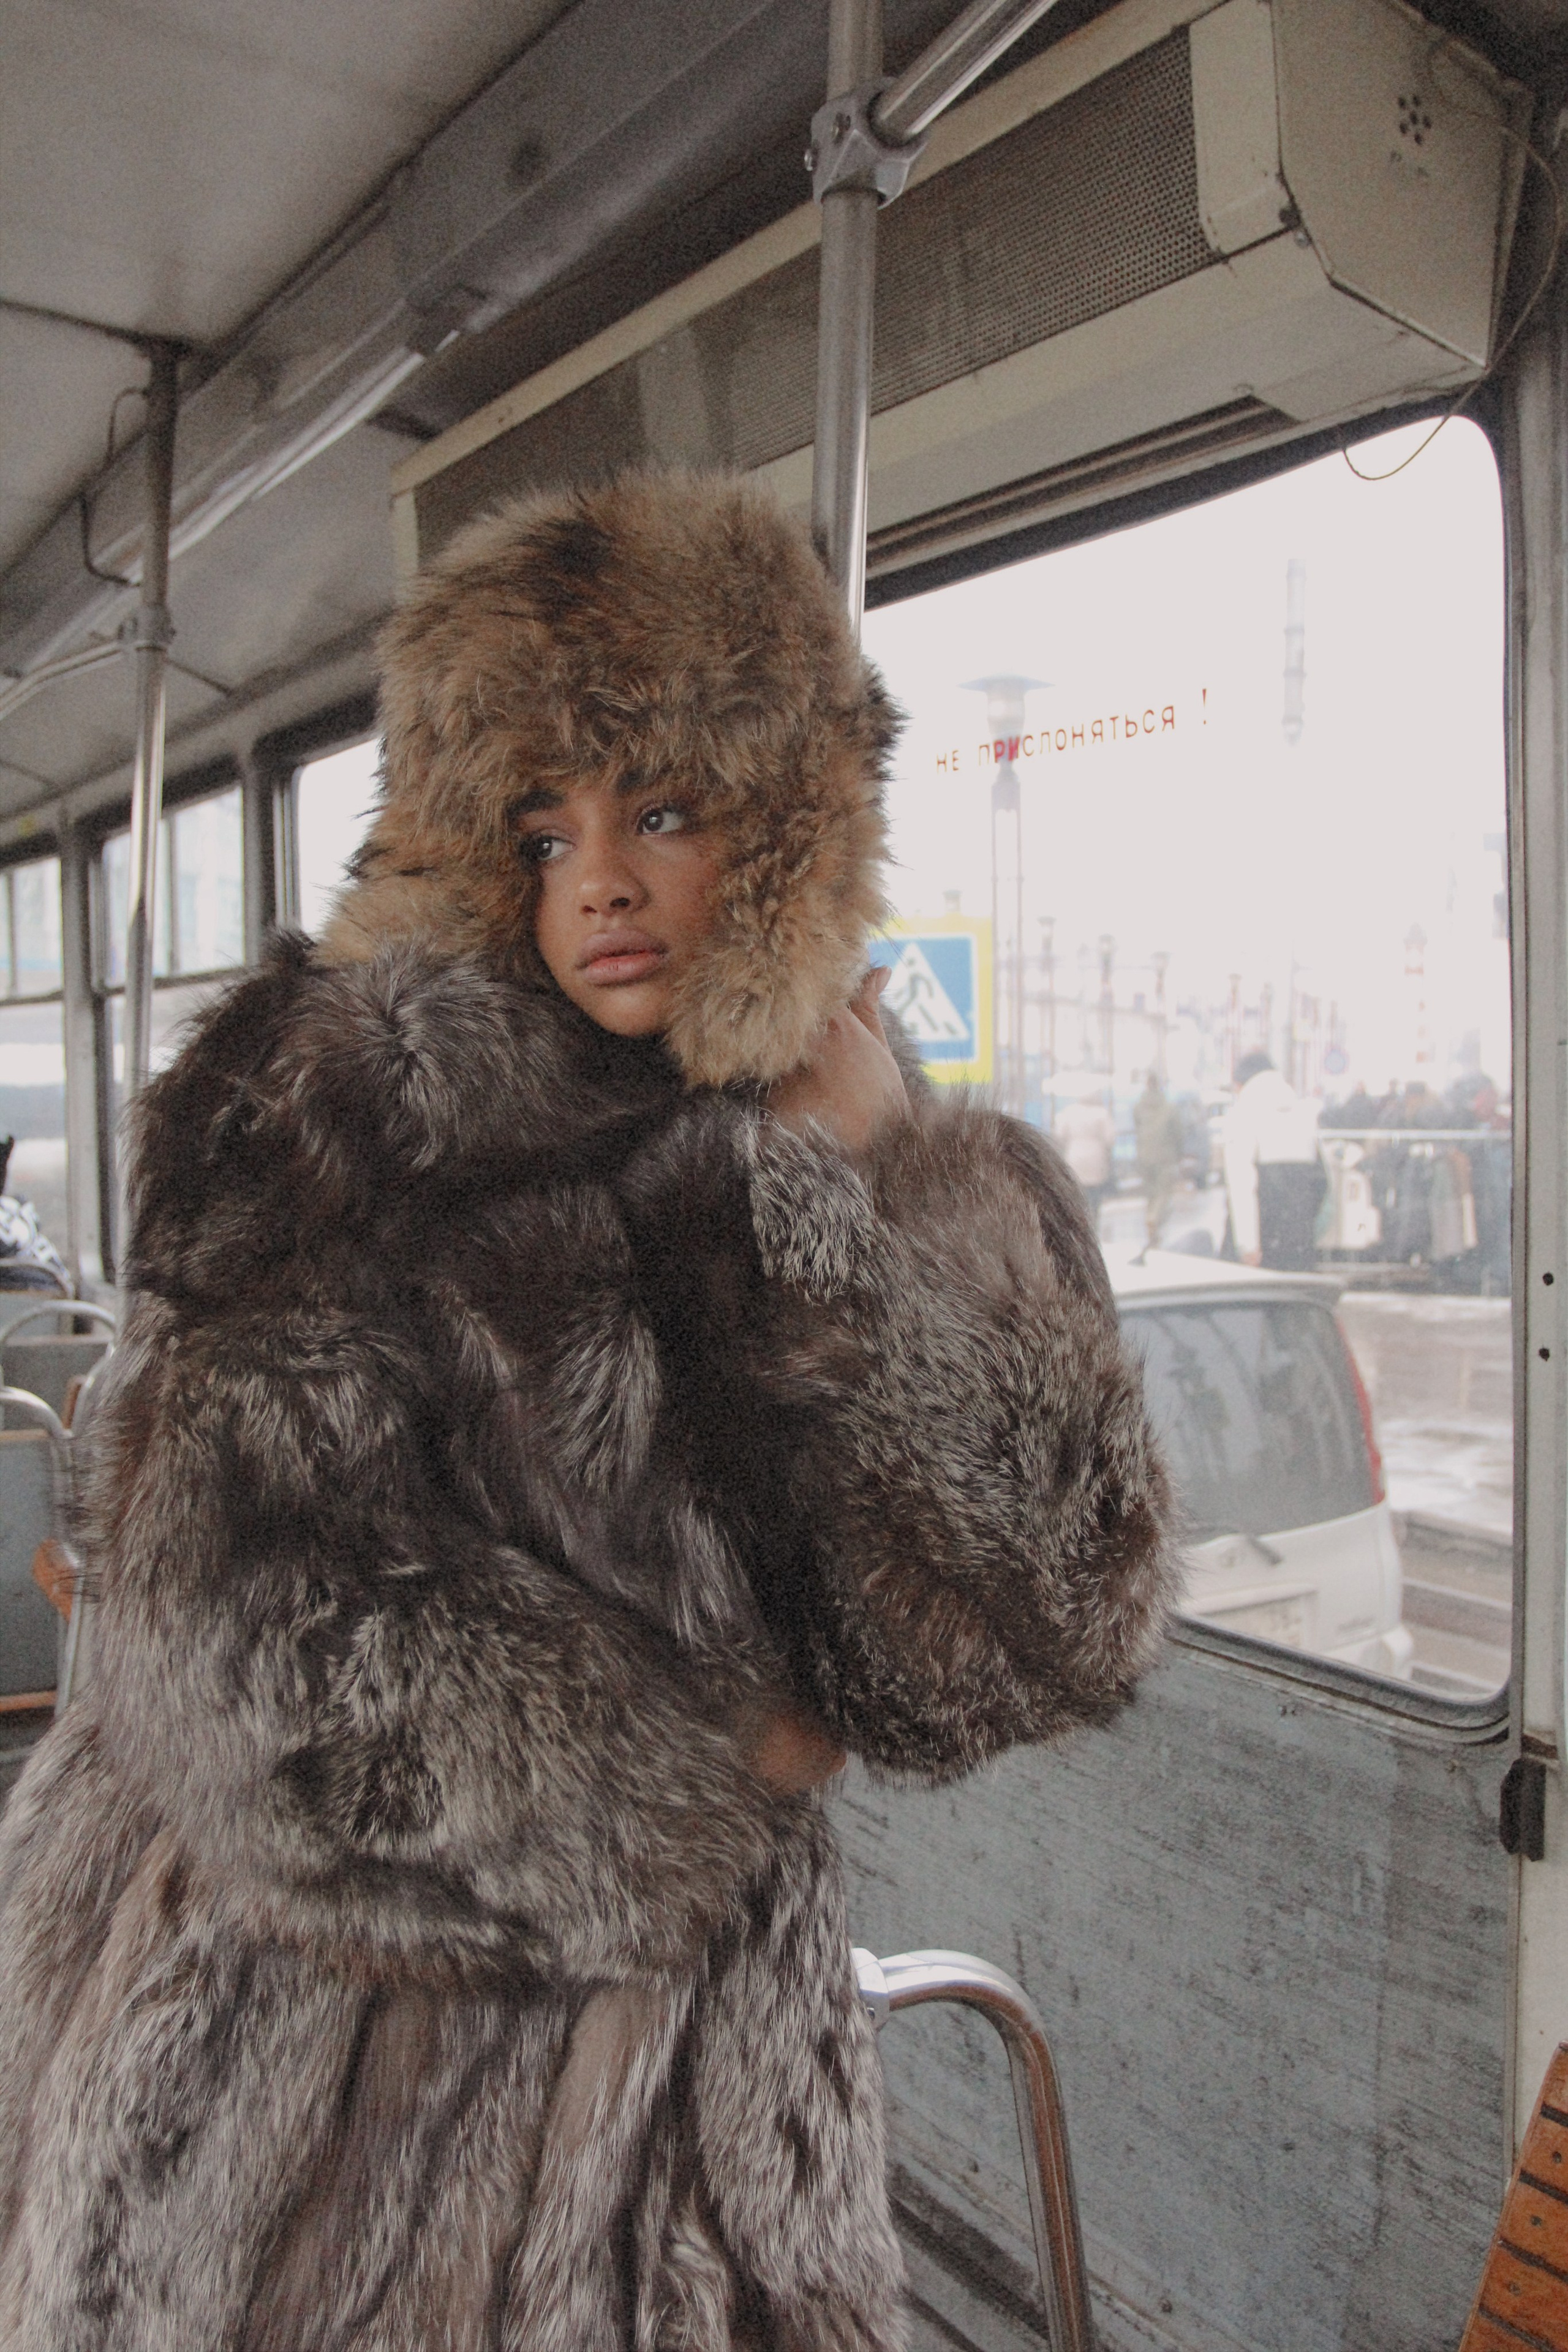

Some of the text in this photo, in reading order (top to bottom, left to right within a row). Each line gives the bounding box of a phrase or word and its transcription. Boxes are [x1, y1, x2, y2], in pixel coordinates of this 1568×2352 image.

[937, 688, 1207, 774] НЕ ПРИСЛОНЯТЬСЯ !
